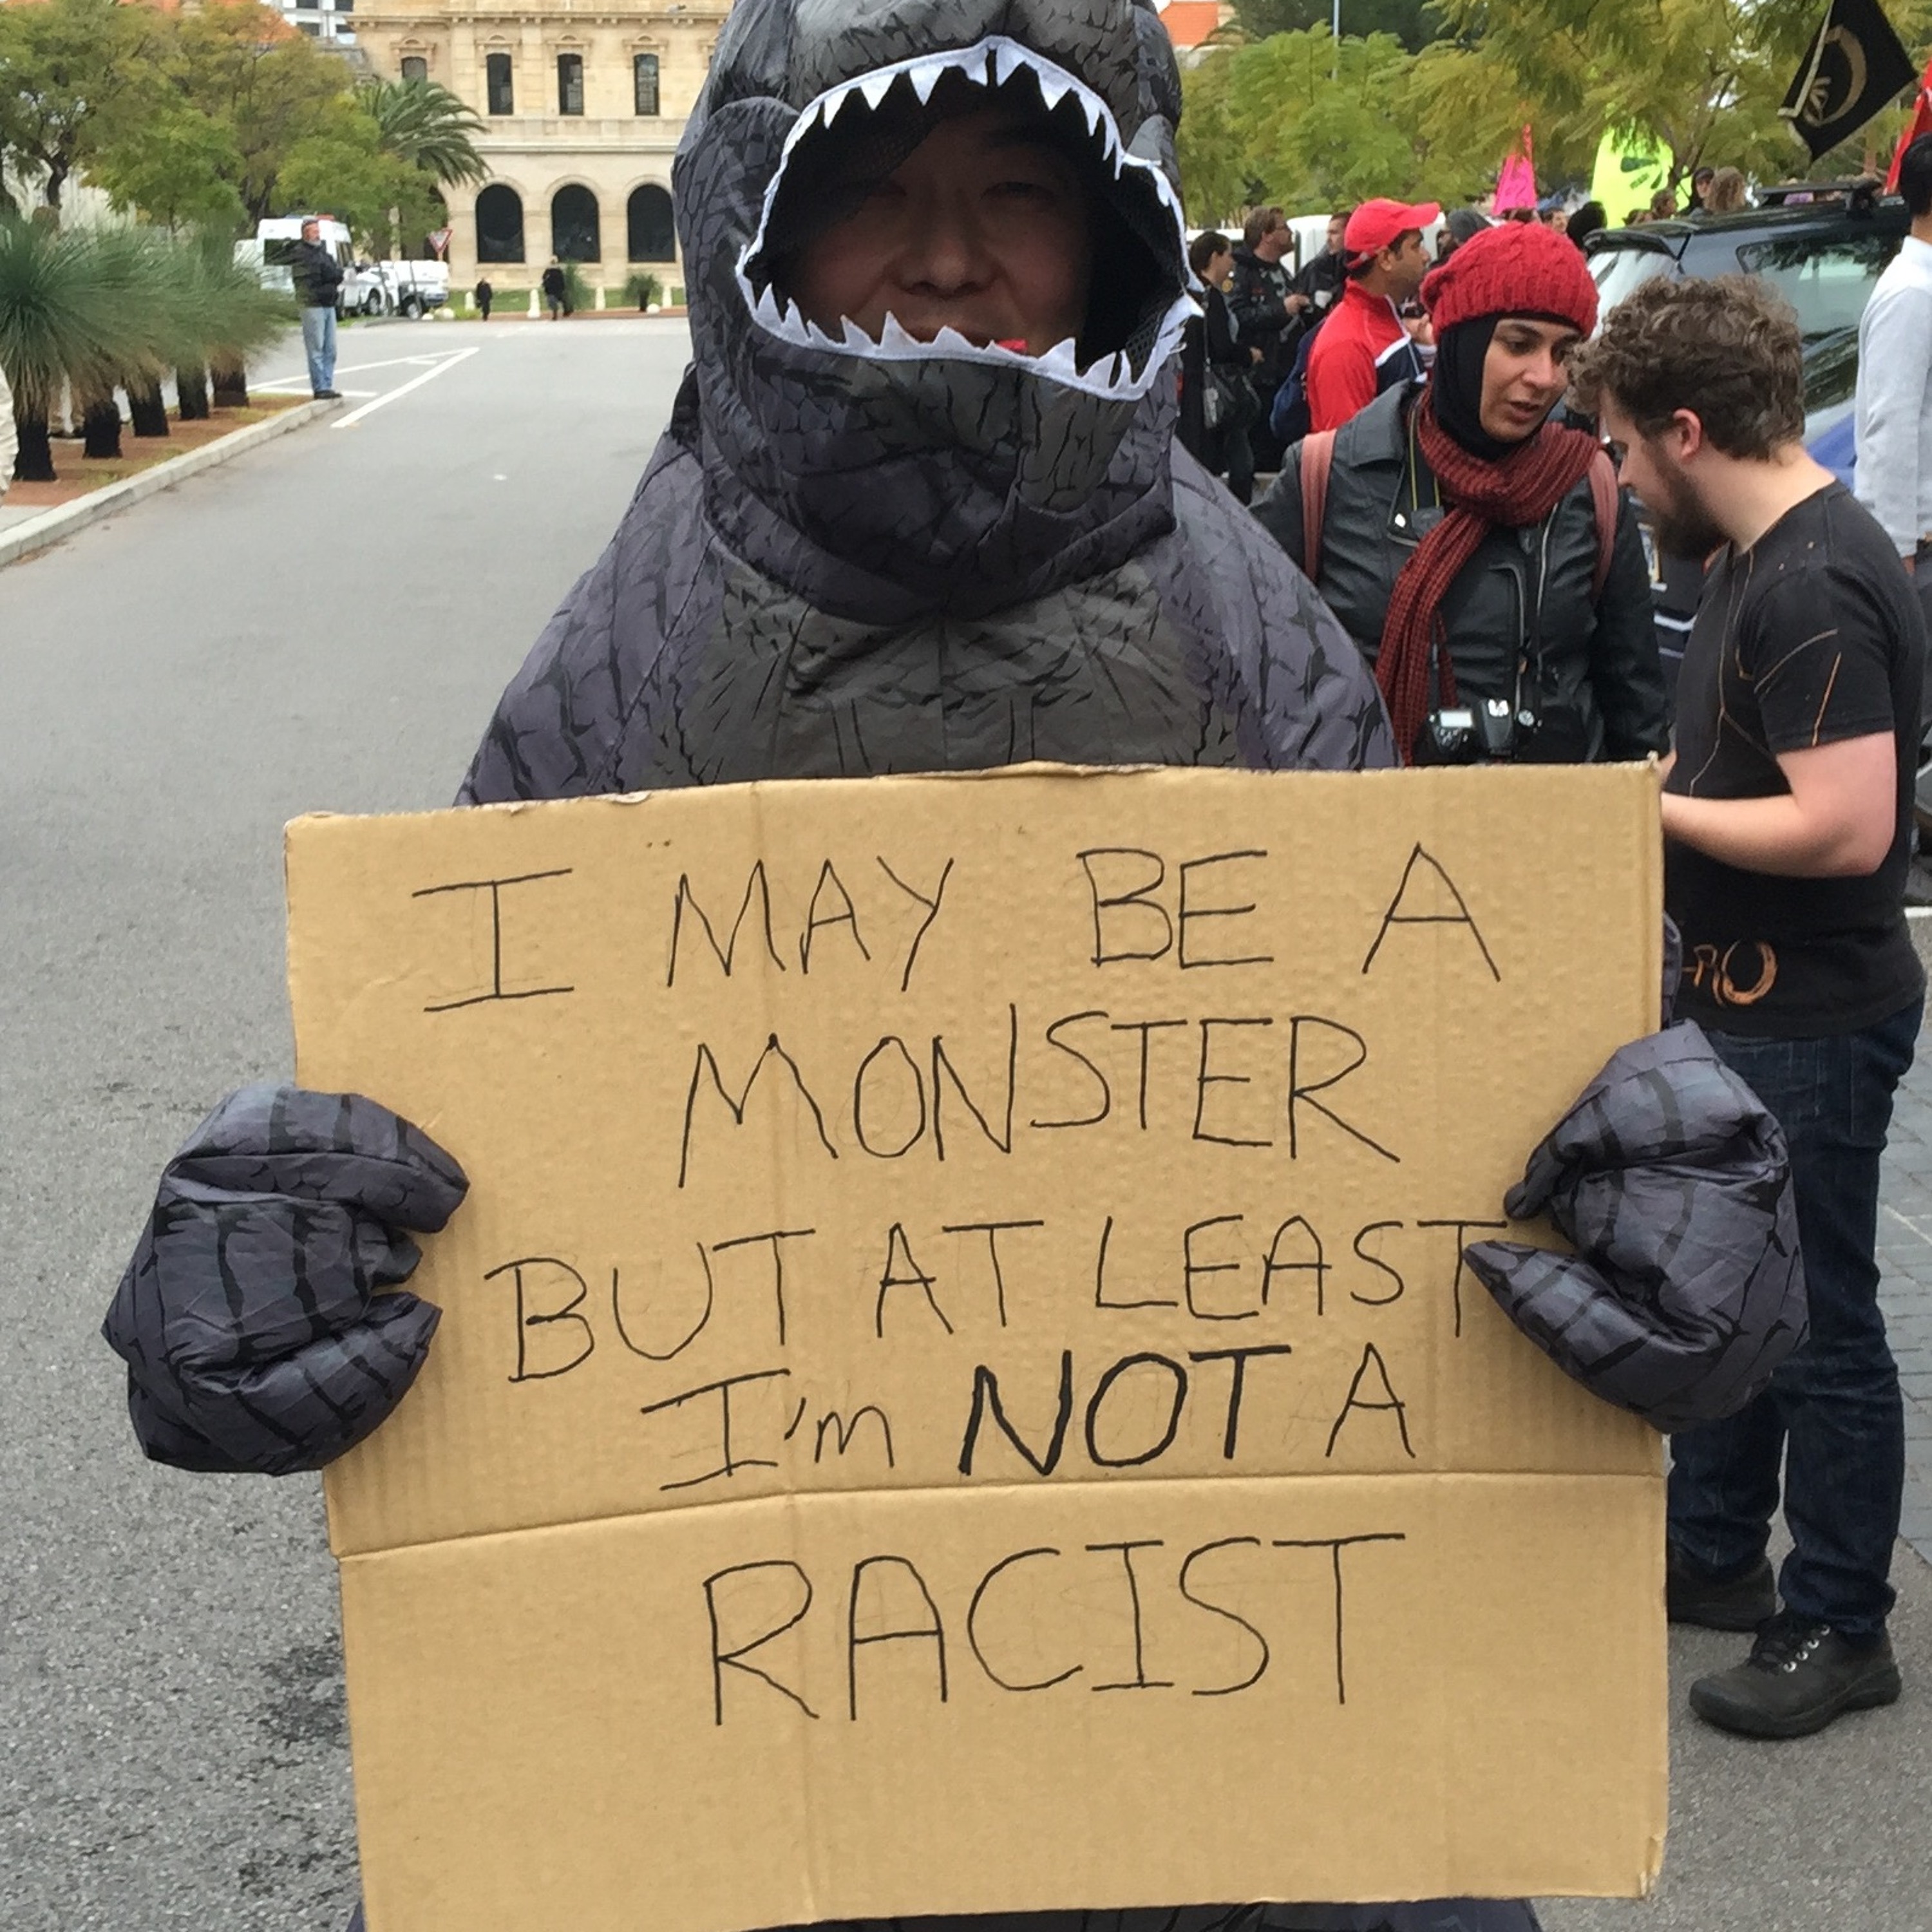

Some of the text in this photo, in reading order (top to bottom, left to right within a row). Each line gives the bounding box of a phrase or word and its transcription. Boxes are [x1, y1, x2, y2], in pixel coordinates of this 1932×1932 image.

[411, 841, 1501, 1013] I MAY BE A
[678, 1003, 1401, 1189] MONSTER
[484, 1214, 1508, 1383] BUT AT LEAST
[641, 1341, 1416, 1492] I'm NOT A
[703, 1532, 1406, 1726] RACIST
